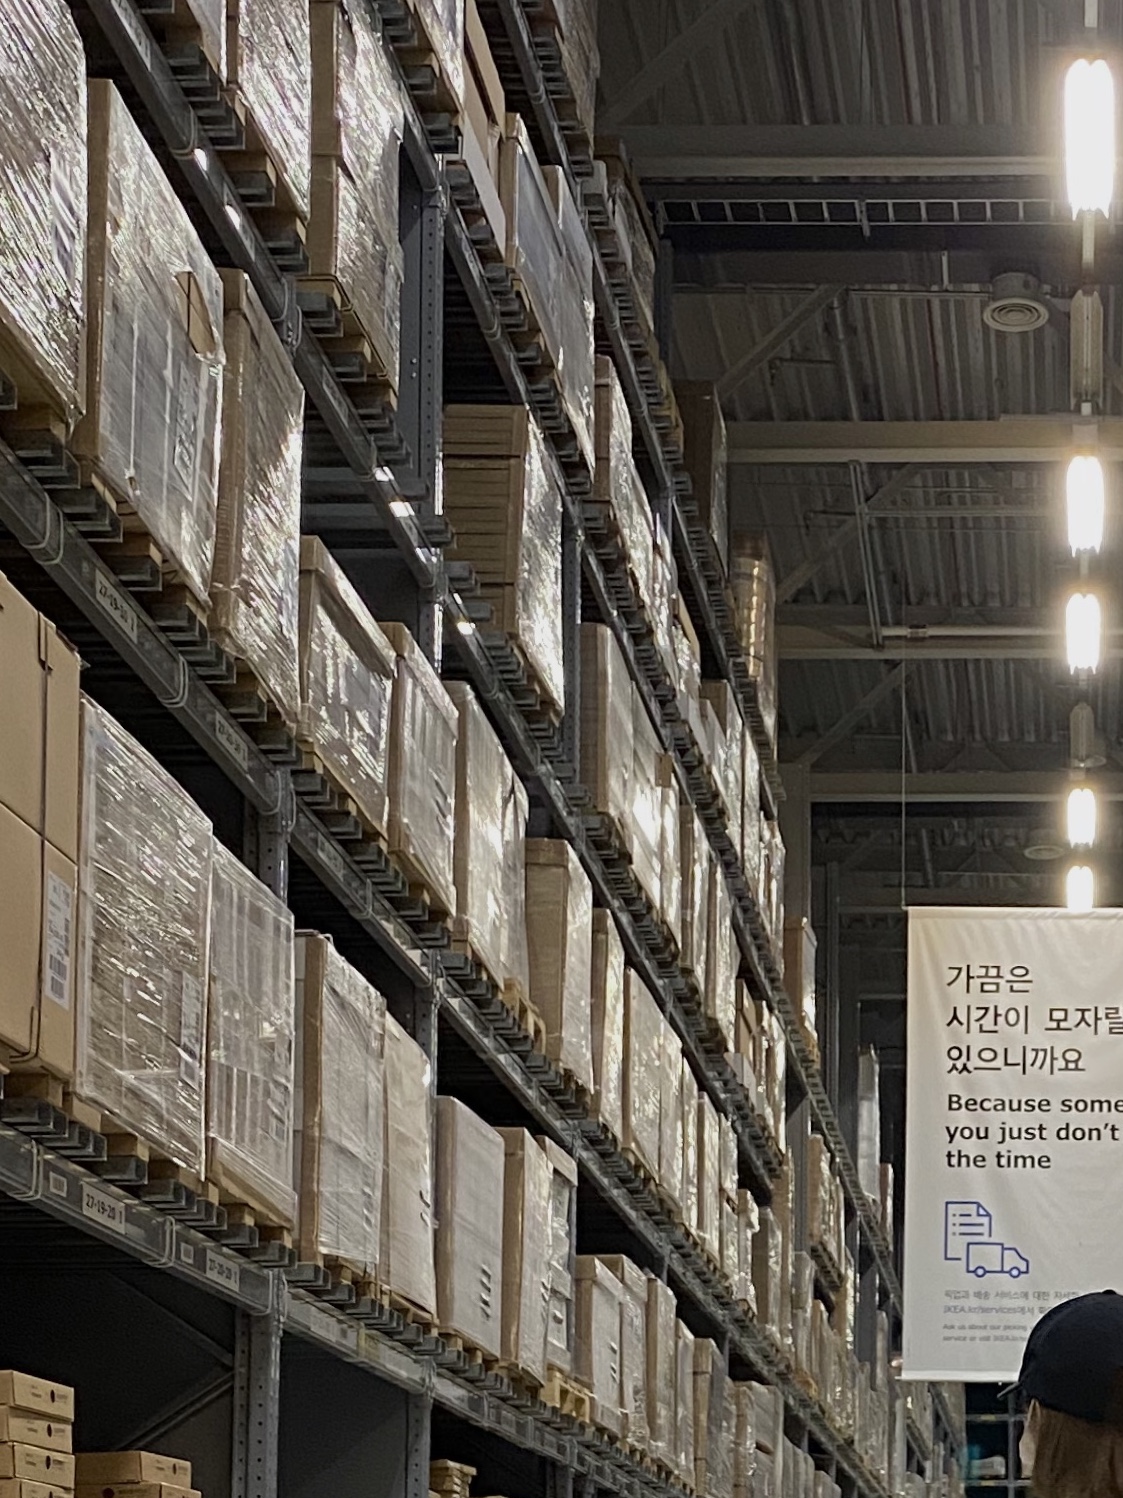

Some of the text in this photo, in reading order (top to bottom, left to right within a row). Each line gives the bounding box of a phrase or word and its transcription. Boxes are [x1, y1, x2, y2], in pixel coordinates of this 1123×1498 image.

[946, 963, 1033, 994] 가끔은
[945, 1004, 1029, 1035] 시간이
[946, 1044, 1086, 1076] 있으니까요
[947, 1093, 1052, 1113] Because
[945, 1125, 990, 1144] you
[997, 1121, 1048, 1145] just
[945, 1149, 1052, 1169] the time
